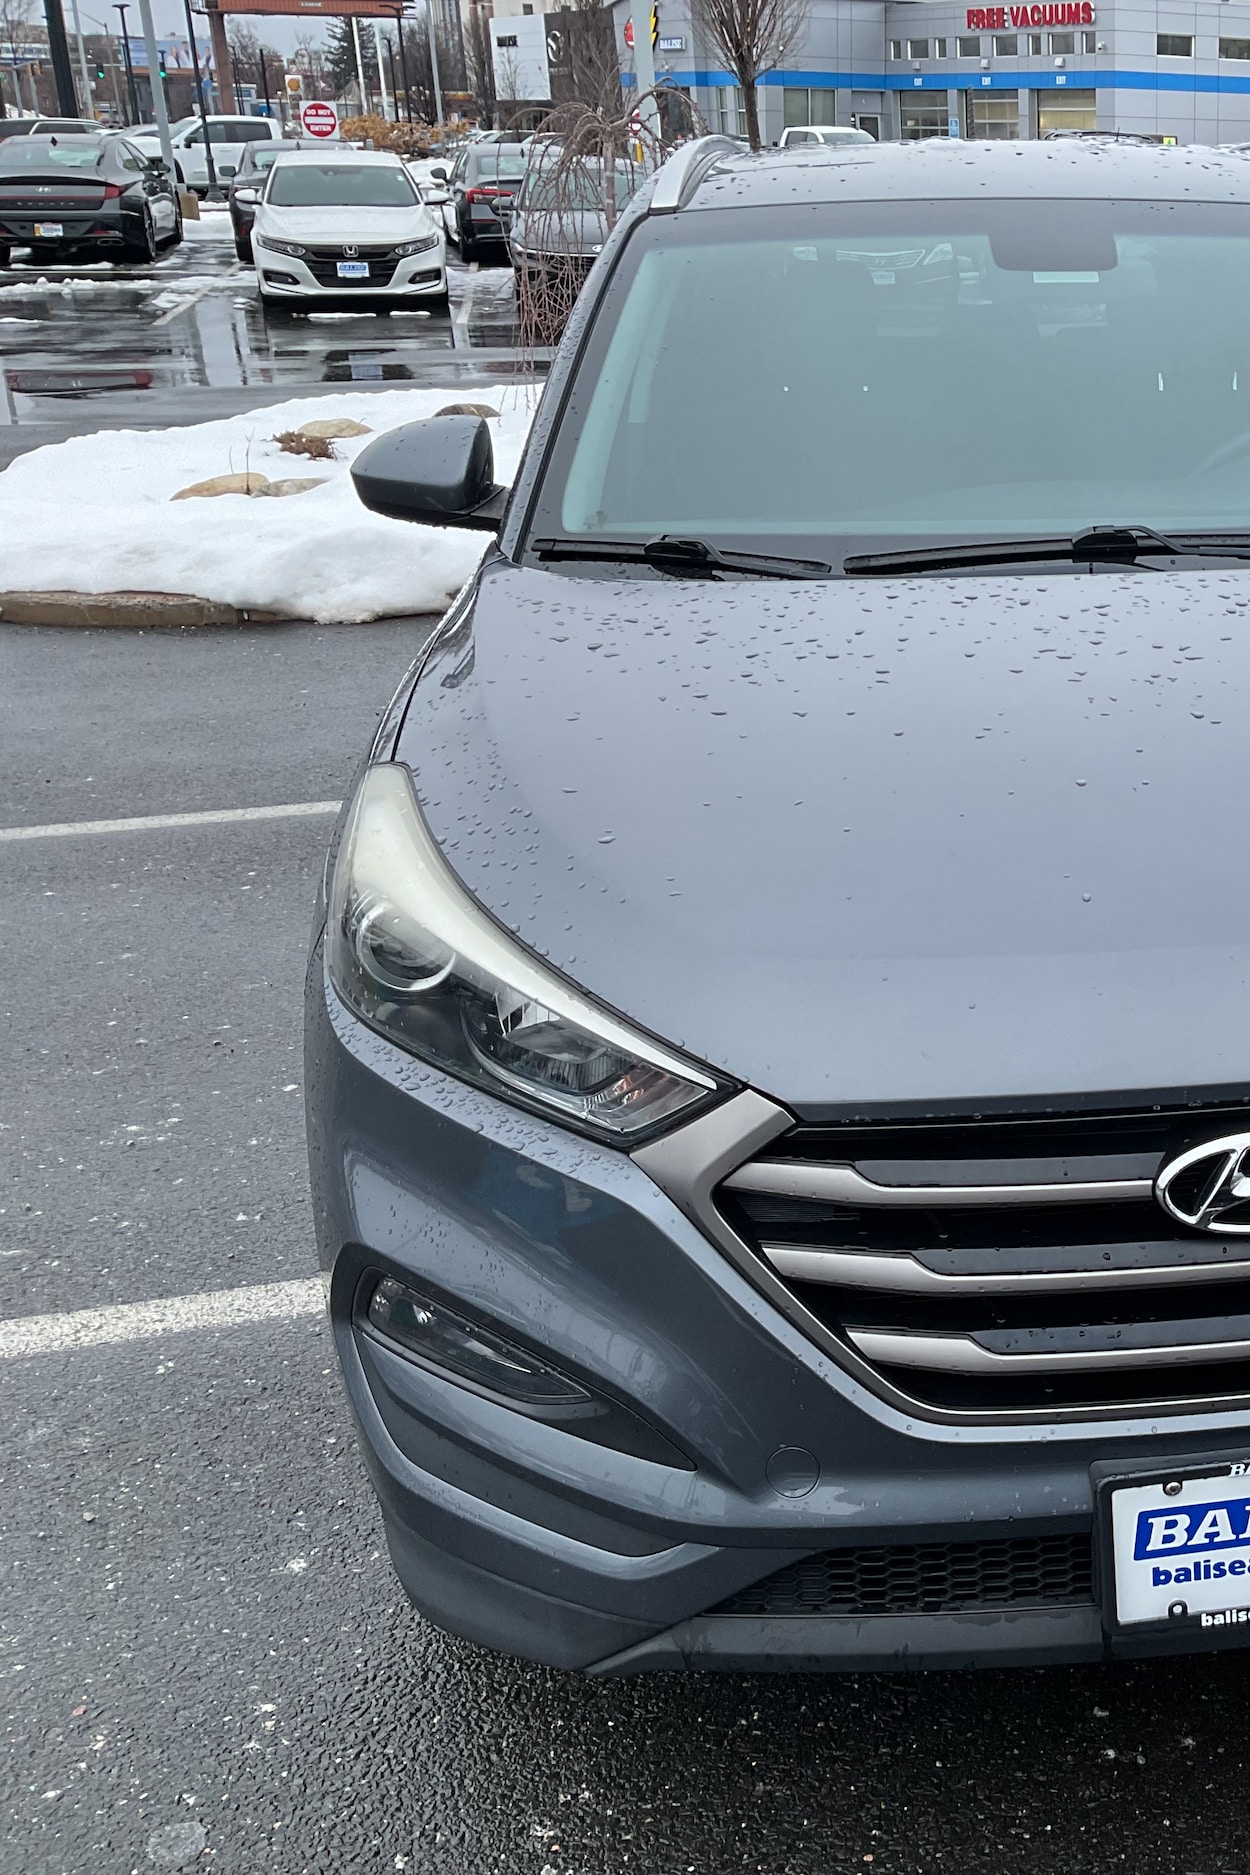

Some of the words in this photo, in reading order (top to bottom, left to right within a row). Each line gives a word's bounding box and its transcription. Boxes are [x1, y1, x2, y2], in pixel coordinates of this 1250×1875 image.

[967, 7, 1008, 29] FREE
[1009, 2, 1095, 27] VACUUMS
[660, 39, 682, 49] BALISE
[1056, 76, 1066, 85] EXIT
[310, 124, 332, 132] ENTER
